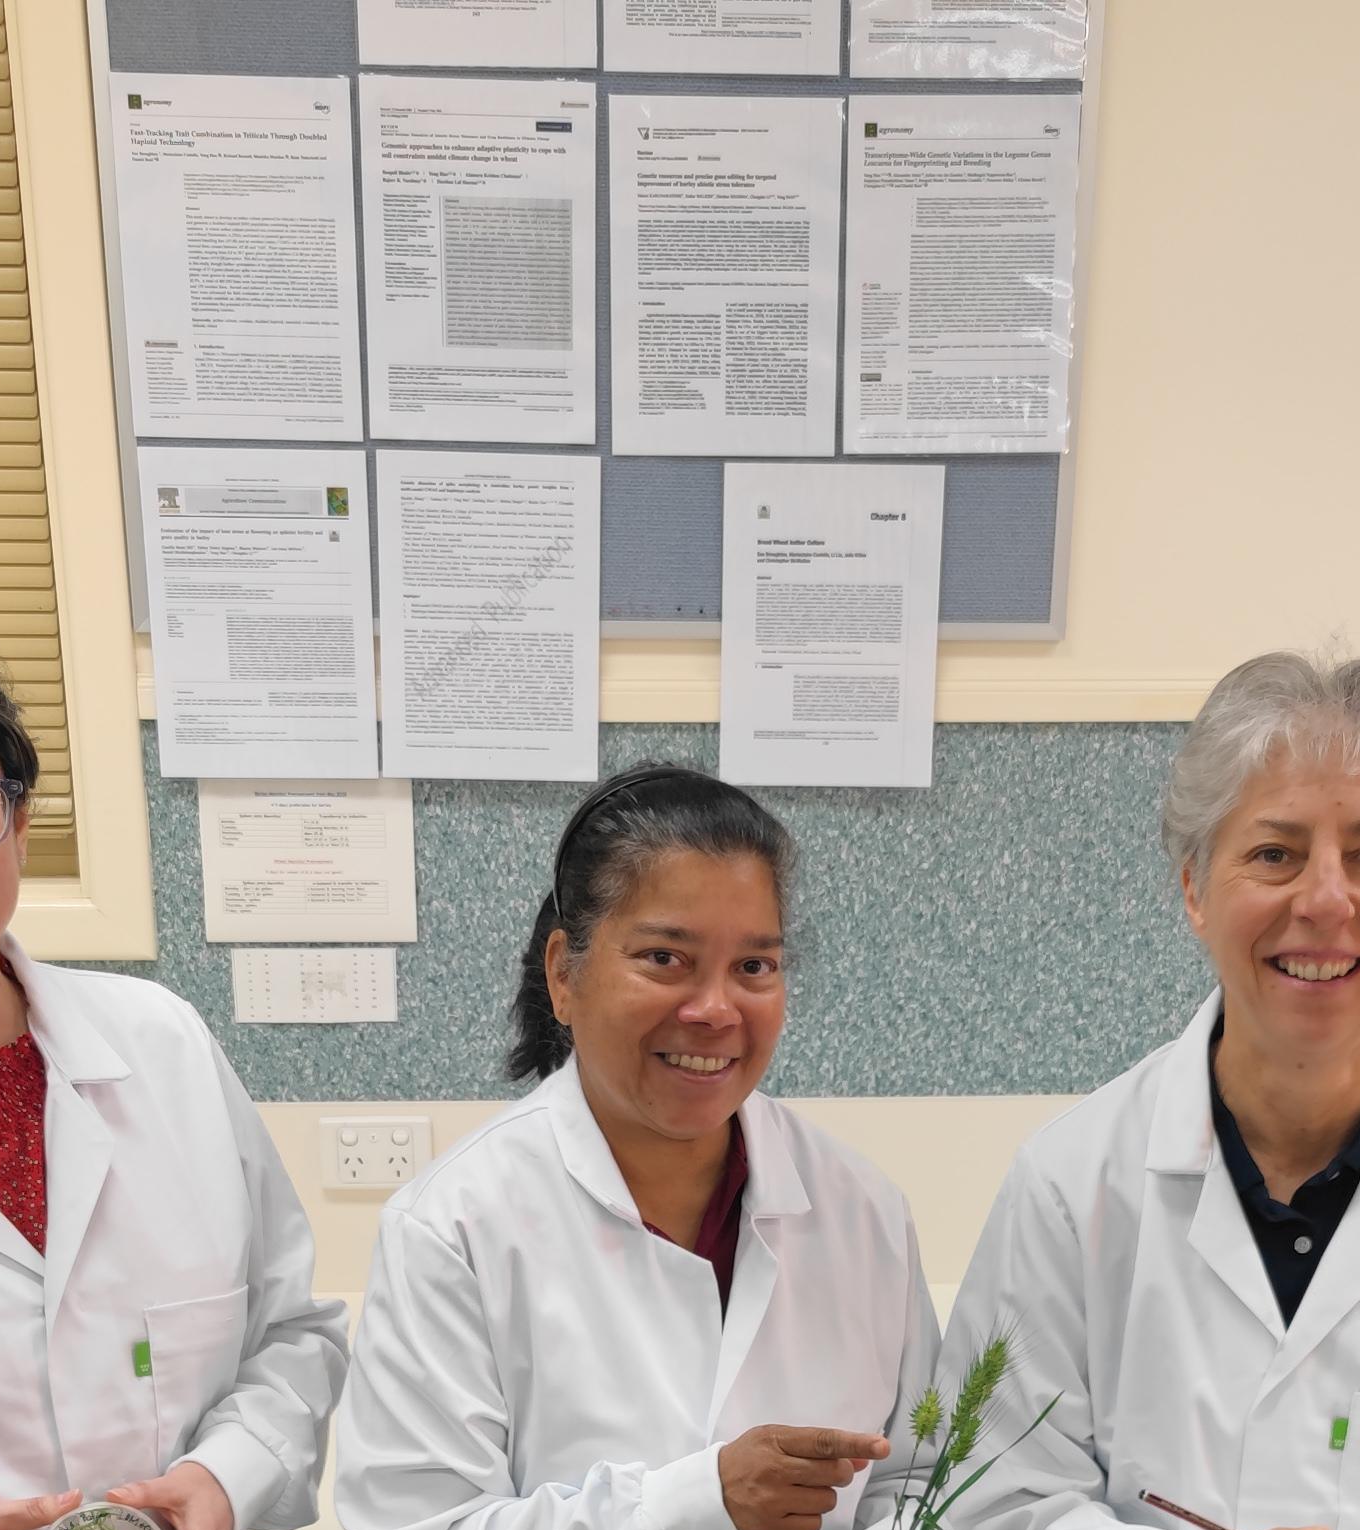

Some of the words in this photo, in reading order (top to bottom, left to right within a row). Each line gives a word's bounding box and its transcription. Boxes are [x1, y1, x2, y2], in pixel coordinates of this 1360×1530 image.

[879, 127, 914, 135] agronomy
[270, 133, 298, 141] Through
[159, 140, 195, 148] Technology
[864, 151, 926, 160] Transcriptome-Wide
[1004, 152, 1030, 160] Legume
[904, 160, 949, 168] Fingerprinting
[963, 160, 992, 168] Breeding
[870, 513, 899, 522] Chapter
[484, 538, 573, 624] Publication
